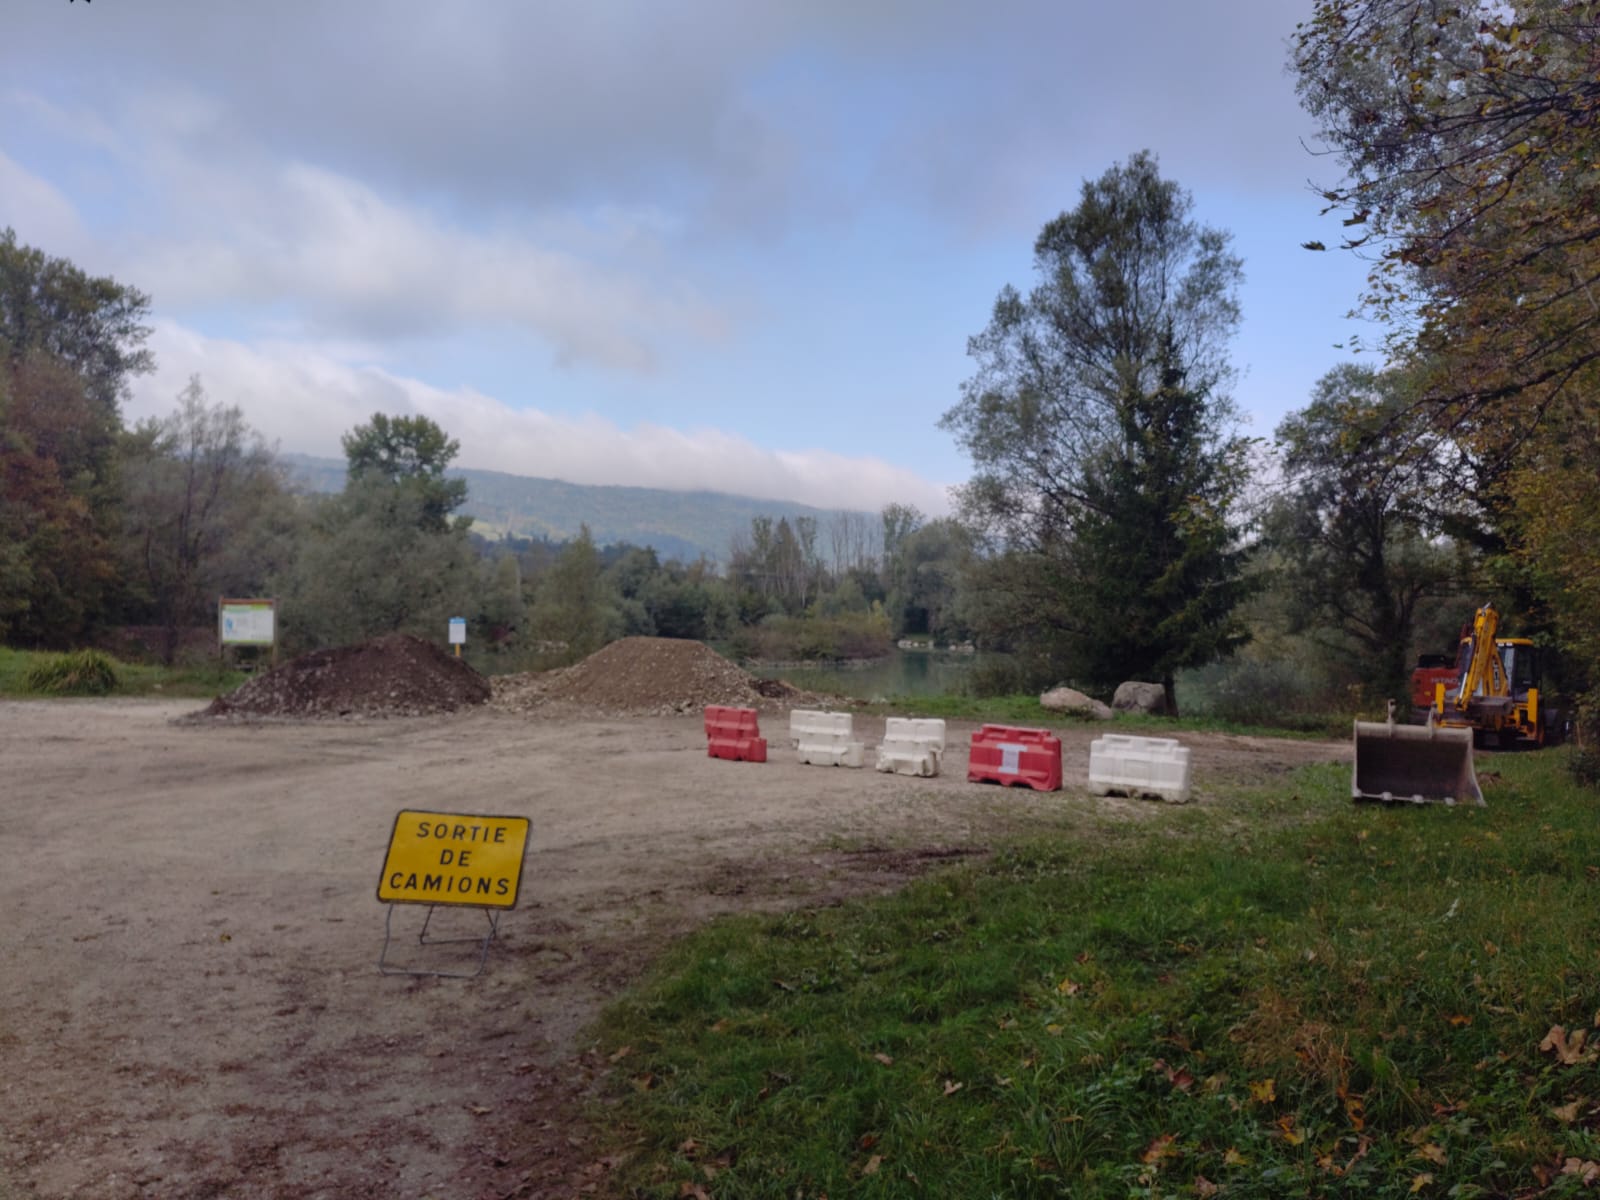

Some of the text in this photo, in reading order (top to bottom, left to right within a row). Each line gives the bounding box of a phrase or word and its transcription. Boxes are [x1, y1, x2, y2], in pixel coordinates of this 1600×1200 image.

[416, 822, 507, 843] SORTIE
[439, 849, 472, 867] DE
[390, 872, 510, 895] CAMIONS
